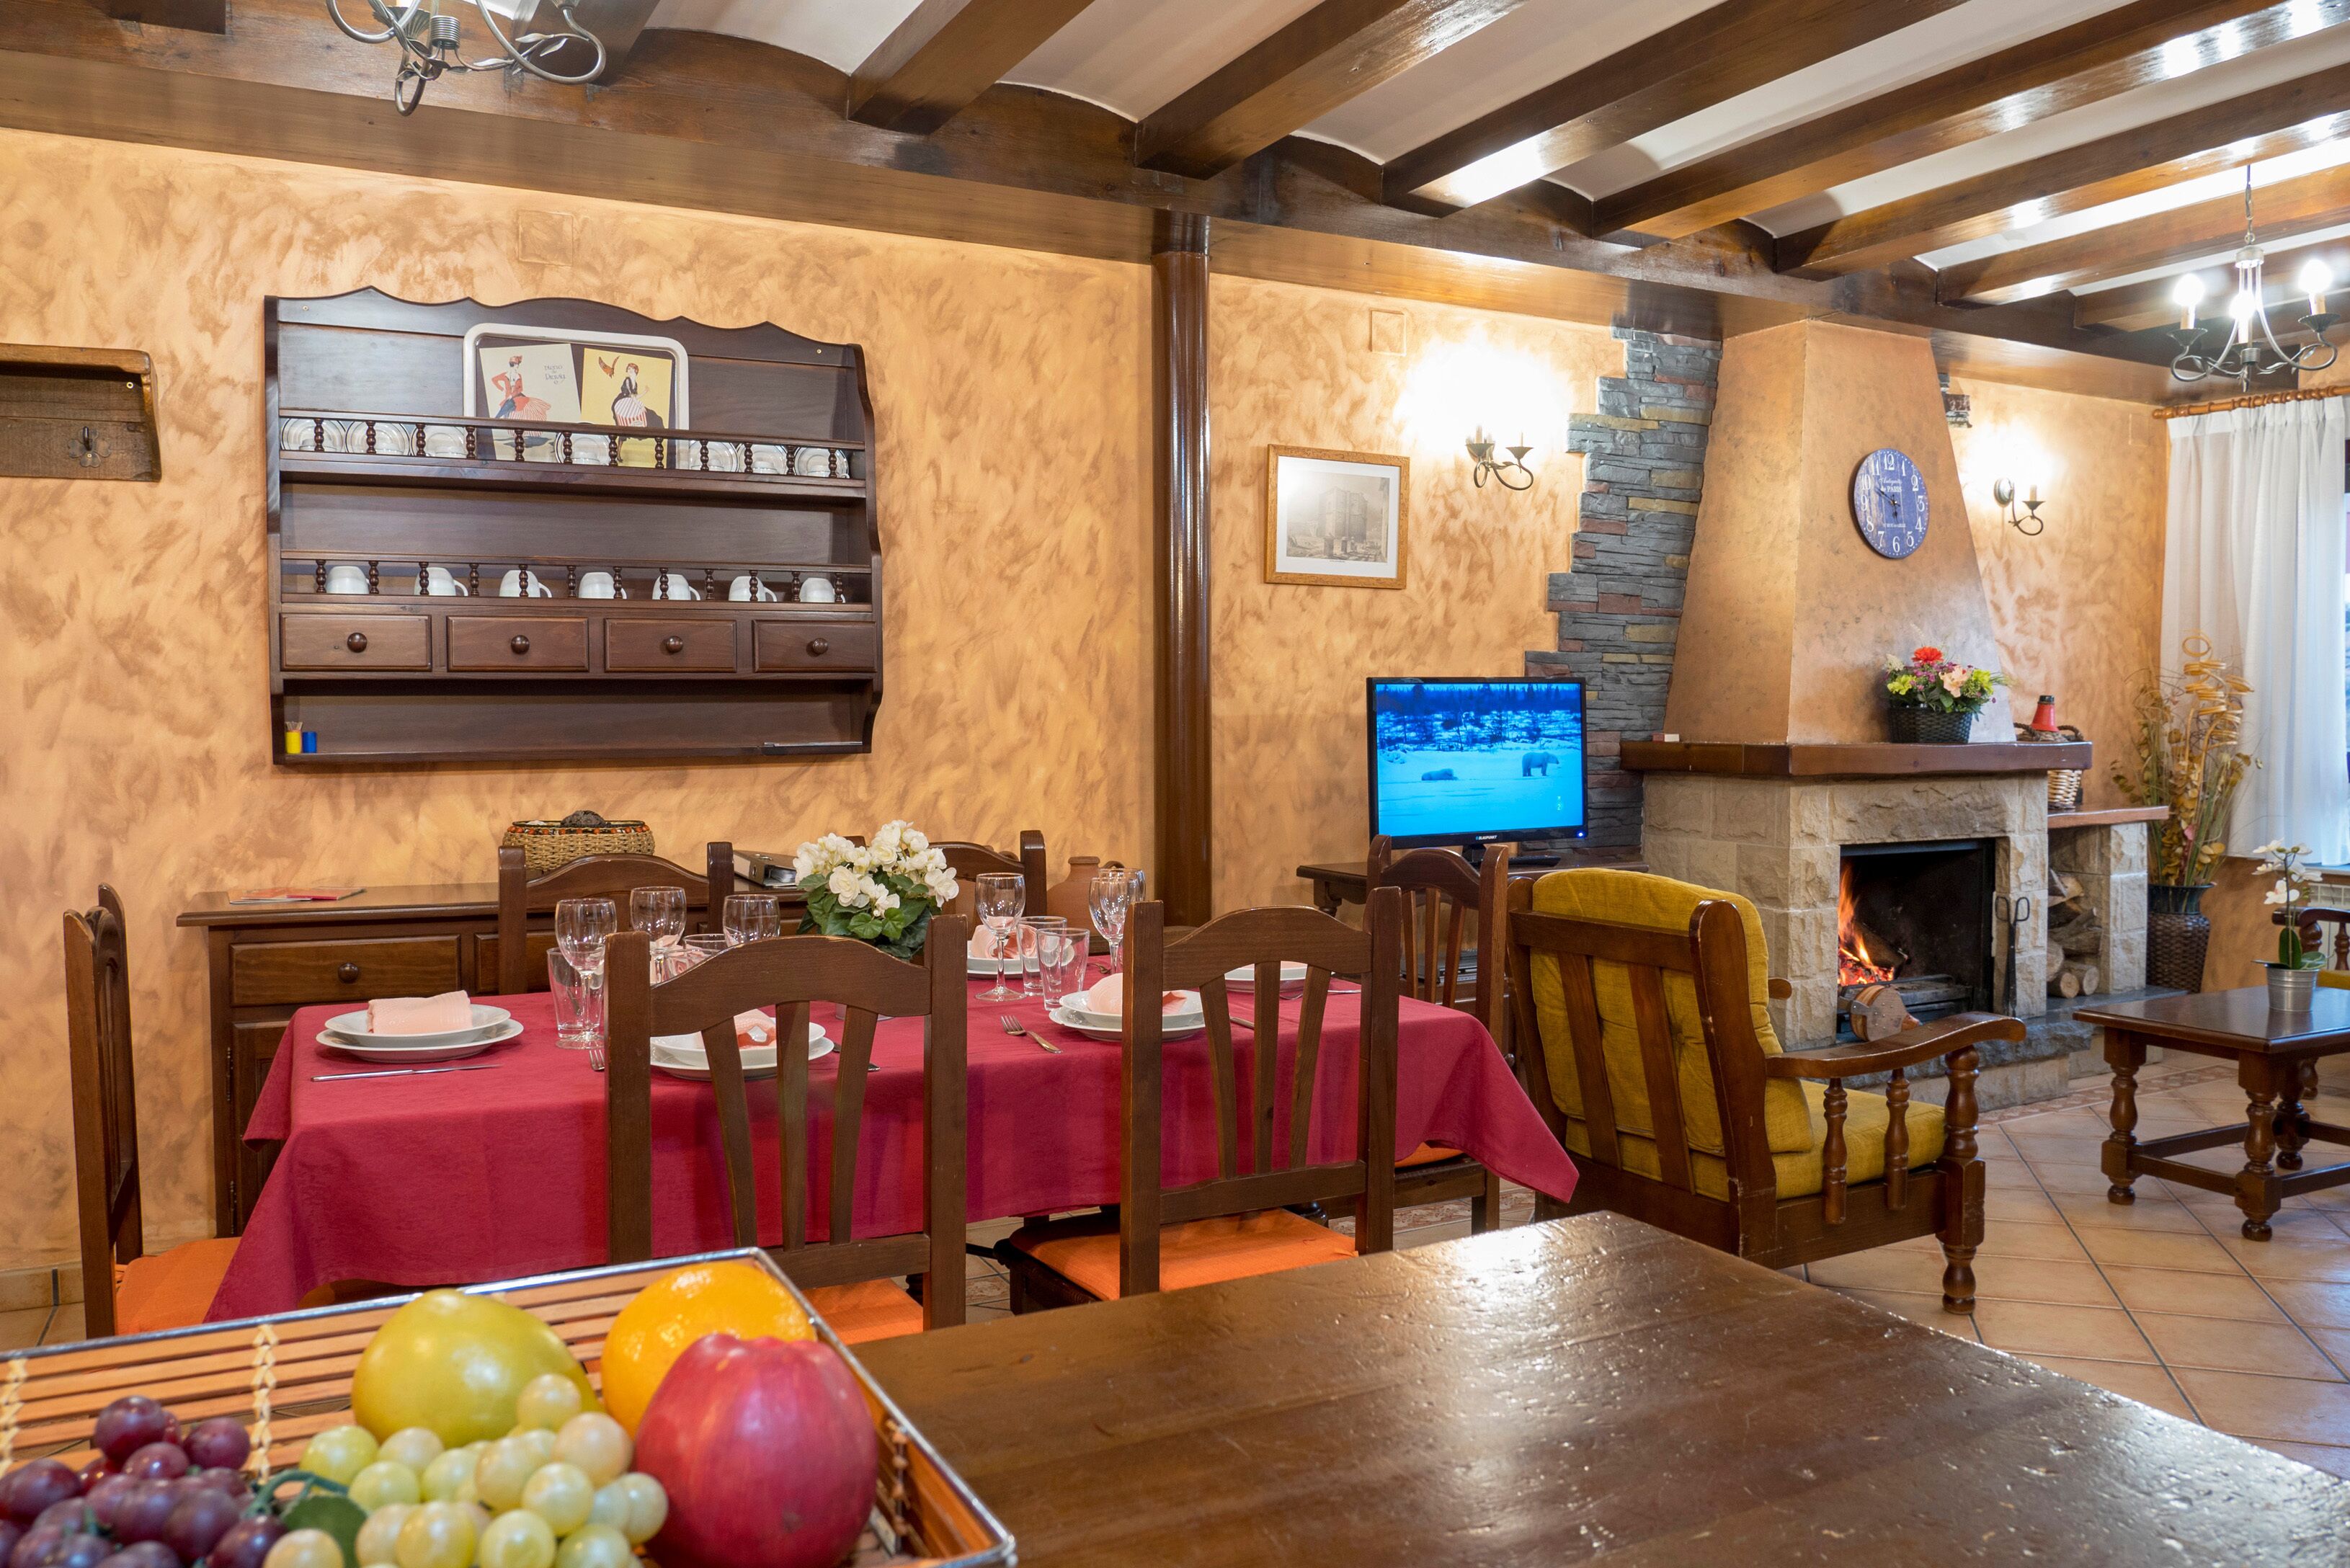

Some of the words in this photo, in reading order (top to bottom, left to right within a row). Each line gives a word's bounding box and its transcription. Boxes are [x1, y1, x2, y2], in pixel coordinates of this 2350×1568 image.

[1871, 459, 1880, 476] 11
[1884, 453, 1895, 471] 12
[1902, 460, 1907, 476] 1
[1861, 474, 1872, 491] 10
[1911, 475, 1919, 491] 2
[1861, 494, 1869, 511] 9
[1918, 495, 1926, 512] 3
[1866, 515, 1874, 533] 8
[1915, 517, 1923, 533] 4
[1877, 530, 1885, 547] 7
[1892, 535, 1900, 553] 6
[1907, 530, 1915, 547] 5
